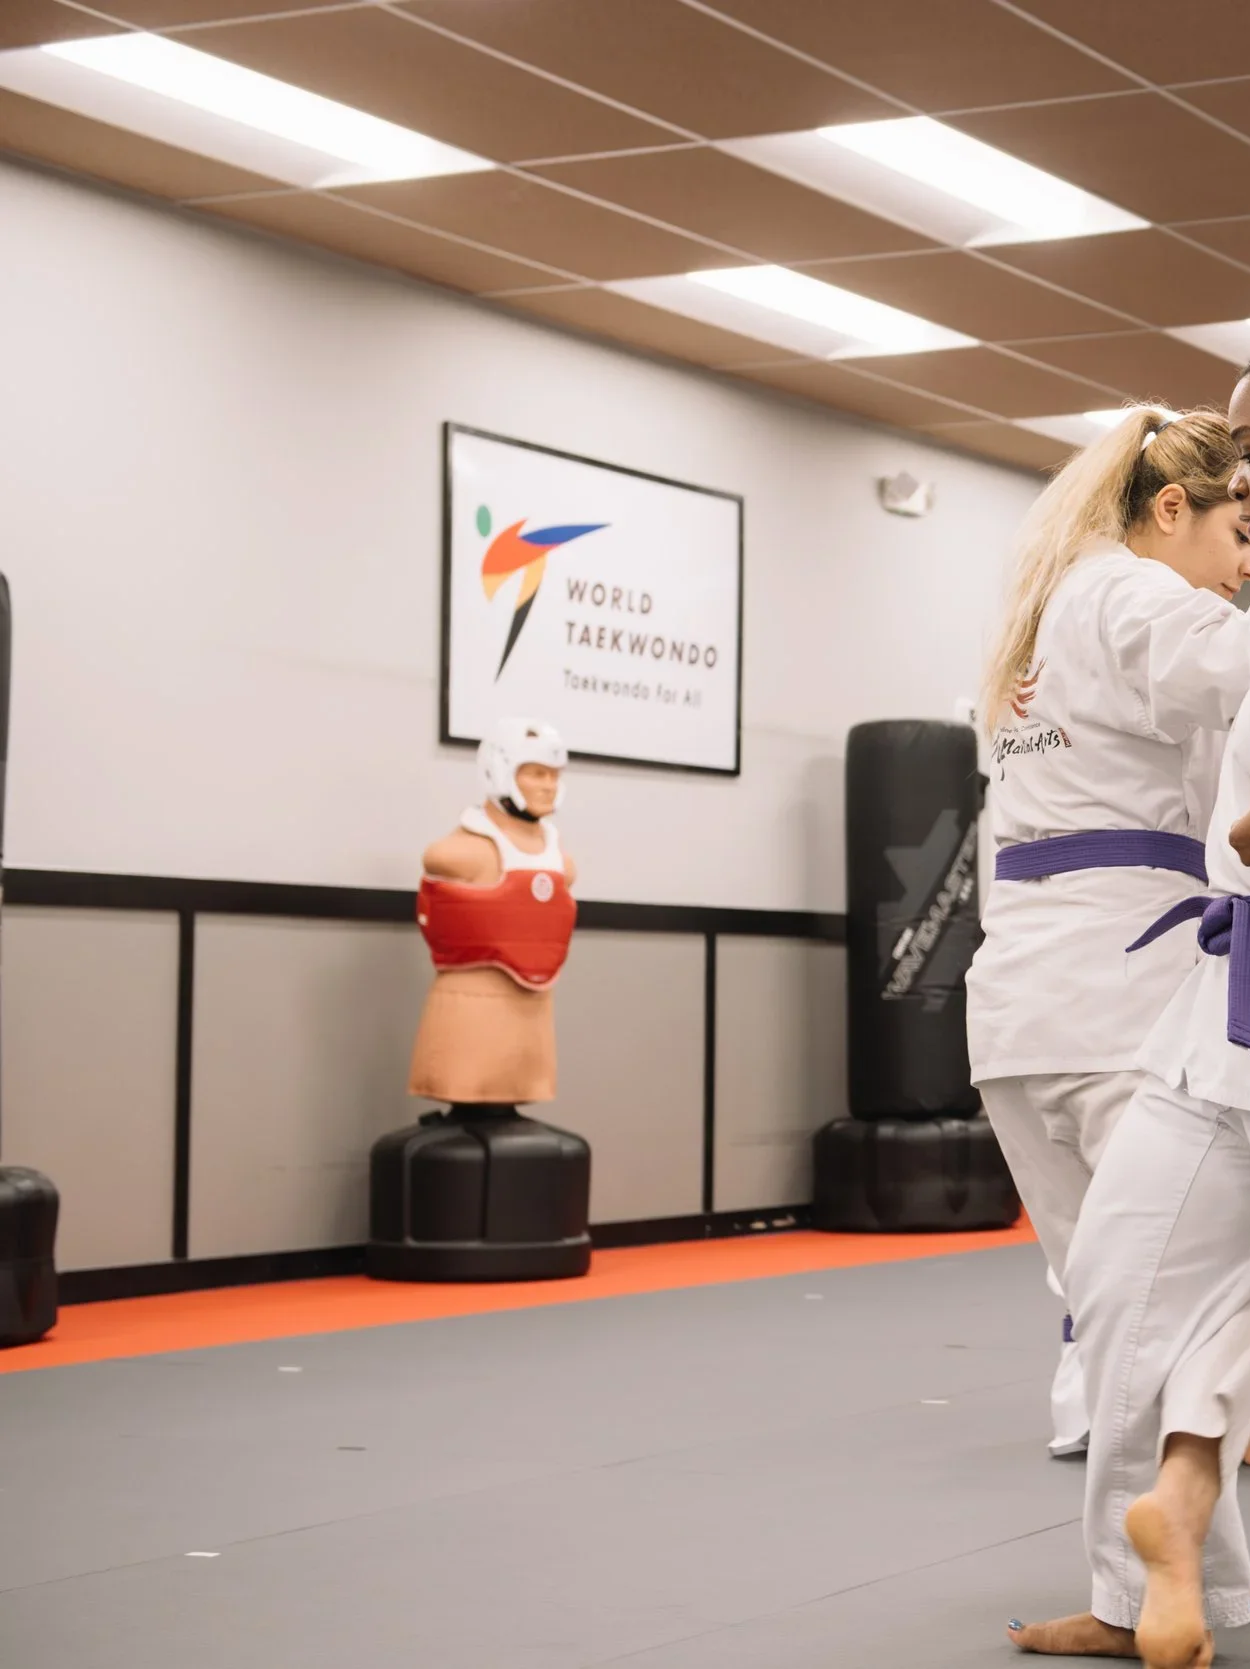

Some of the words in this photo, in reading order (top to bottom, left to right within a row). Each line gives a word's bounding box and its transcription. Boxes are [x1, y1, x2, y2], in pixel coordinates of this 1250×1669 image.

[567, 577, 653, 614] WORLD
[566, 621, 718, 669] TAEKWONDO
[564, 668, 650, 701] Taekwondo
[656, 684, 677, 704] for
[683, 688, 702, 709] All
[1034, 729, 1061, 755] Arts
